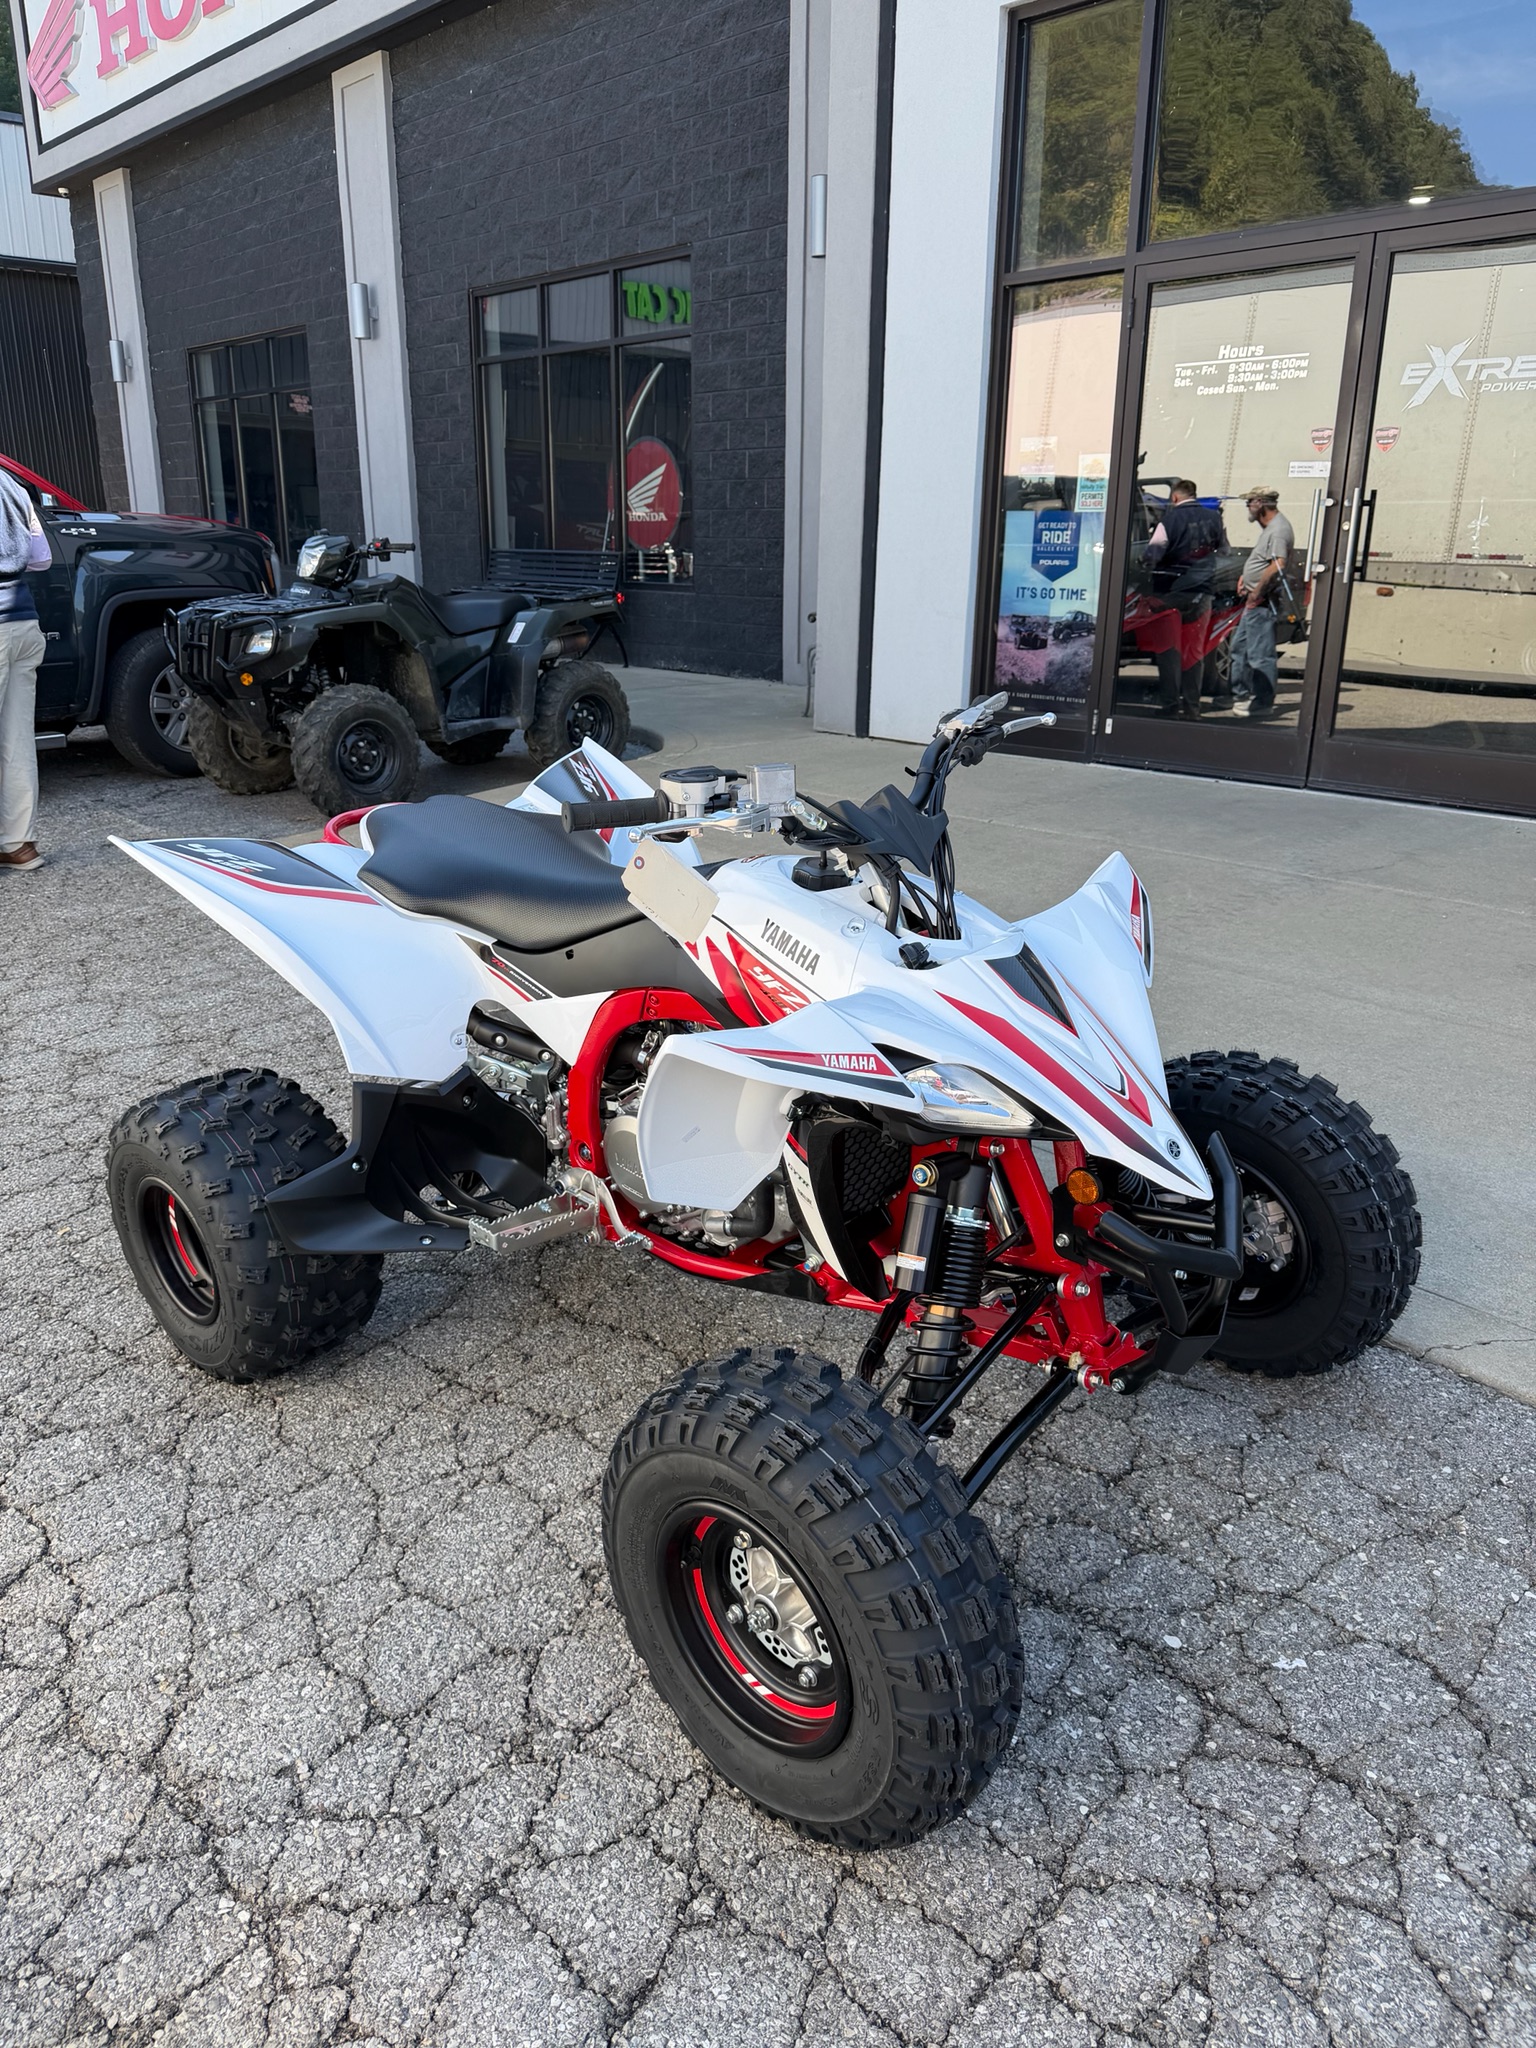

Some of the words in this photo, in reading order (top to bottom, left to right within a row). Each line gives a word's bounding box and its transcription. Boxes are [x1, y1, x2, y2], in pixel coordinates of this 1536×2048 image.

[1218, 344, 1265, 360] Hours
[1175, 367, 1194, 378] Tue.
[1201, 365, 1218, 376] Fri.
[1271, 358, 1309, 370] 6:00PM
[1174, 377, 1194, 388] Sat.
[1270, 369, 1308, 381] 3:00PM
[1226, 382, 1248, 394] Sun.
[1254, 381, 1279, 392] Mon.
[627, 511, 668, 522] HONDA
[1037, 521, 1050, 529] GET
[1050, 521, 1067, 529] READY
[1041, 530, 1072, 545] RIDE
[1038, 558, 1071, 566] POLARIS
[1016, 586, 1038, 599] IT'S
[1040, 587, 1056, 600] GO
[1059, 588, 1087, 601] TIME
[1031, 693, 1056, 701] ASSOCIATE
[760, 917, 821, 976] YAMAHA
[747, 965, 810, 1010] YFZ
[820, 1053, 878, 1071] YAMAHA
